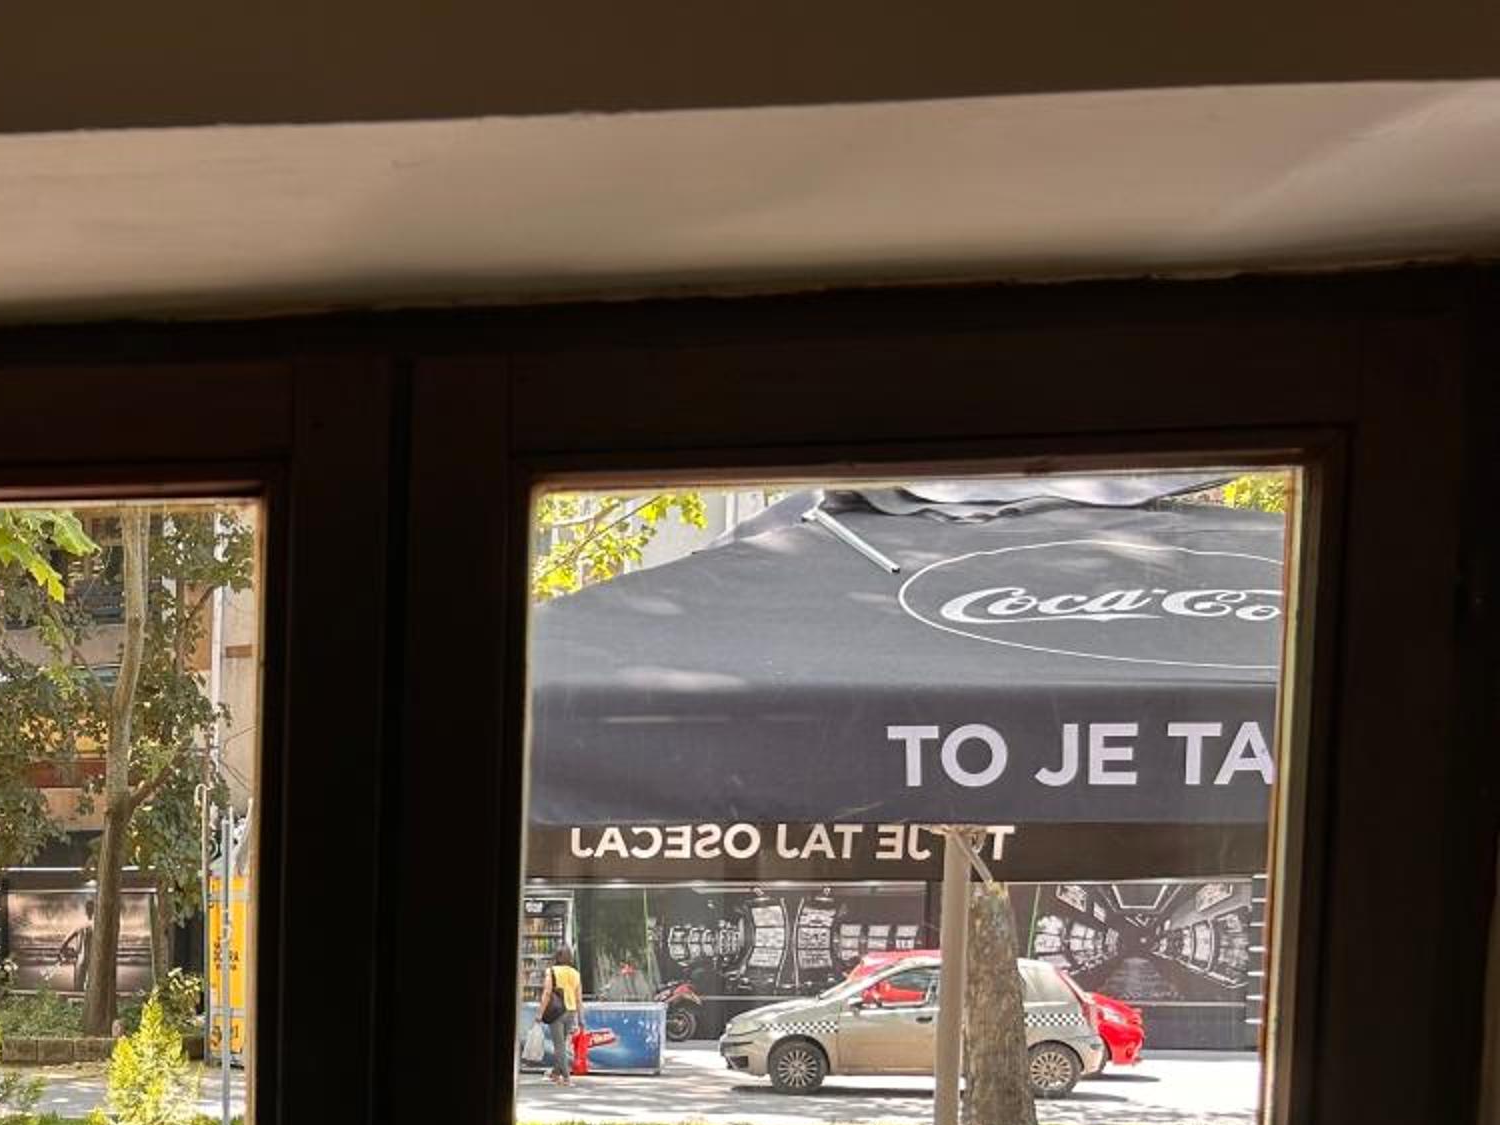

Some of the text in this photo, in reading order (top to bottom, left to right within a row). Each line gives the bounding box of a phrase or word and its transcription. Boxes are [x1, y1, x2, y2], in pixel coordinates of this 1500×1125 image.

[887, 721, 1274, 787] TO JE TA
